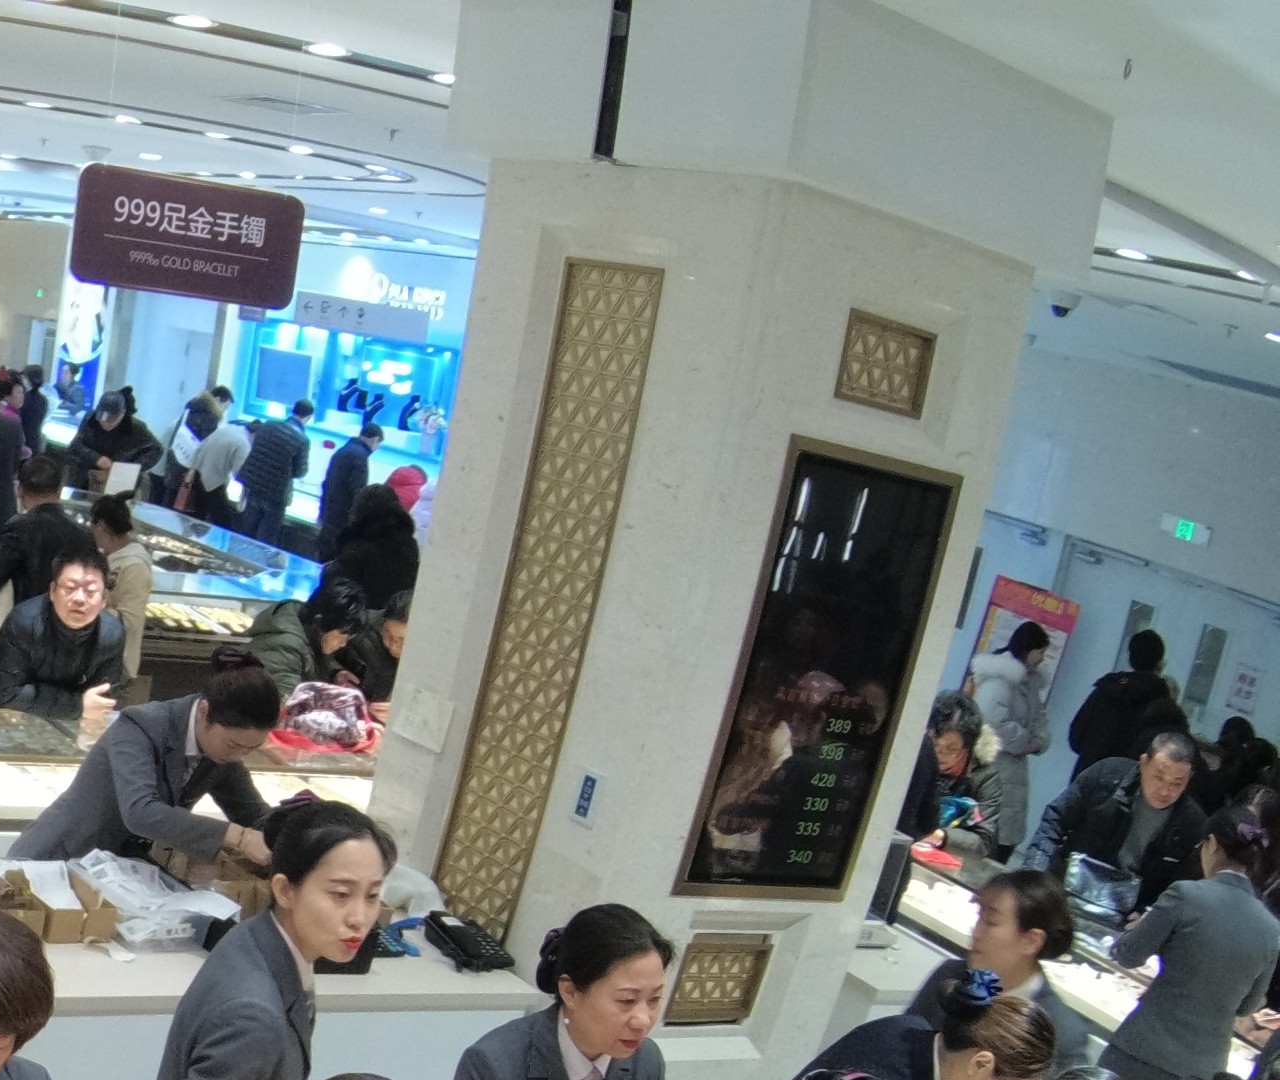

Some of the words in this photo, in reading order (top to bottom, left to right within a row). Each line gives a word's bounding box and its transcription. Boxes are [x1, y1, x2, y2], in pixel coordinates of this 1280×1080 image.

[114, 196, 267, 247] 999足金手镯
[162, 255, 190, 272] GOLD
[193, 259, 240, 277] BRACELET
[826, 718, 852, 734] 389
[818, 745, 845, 761] 398
[810, 773, 837, 787] 428
[802, 797, 829, 812] 330
[795, 821, 821, 836] 335
[786, 850, 813, 864] 340
